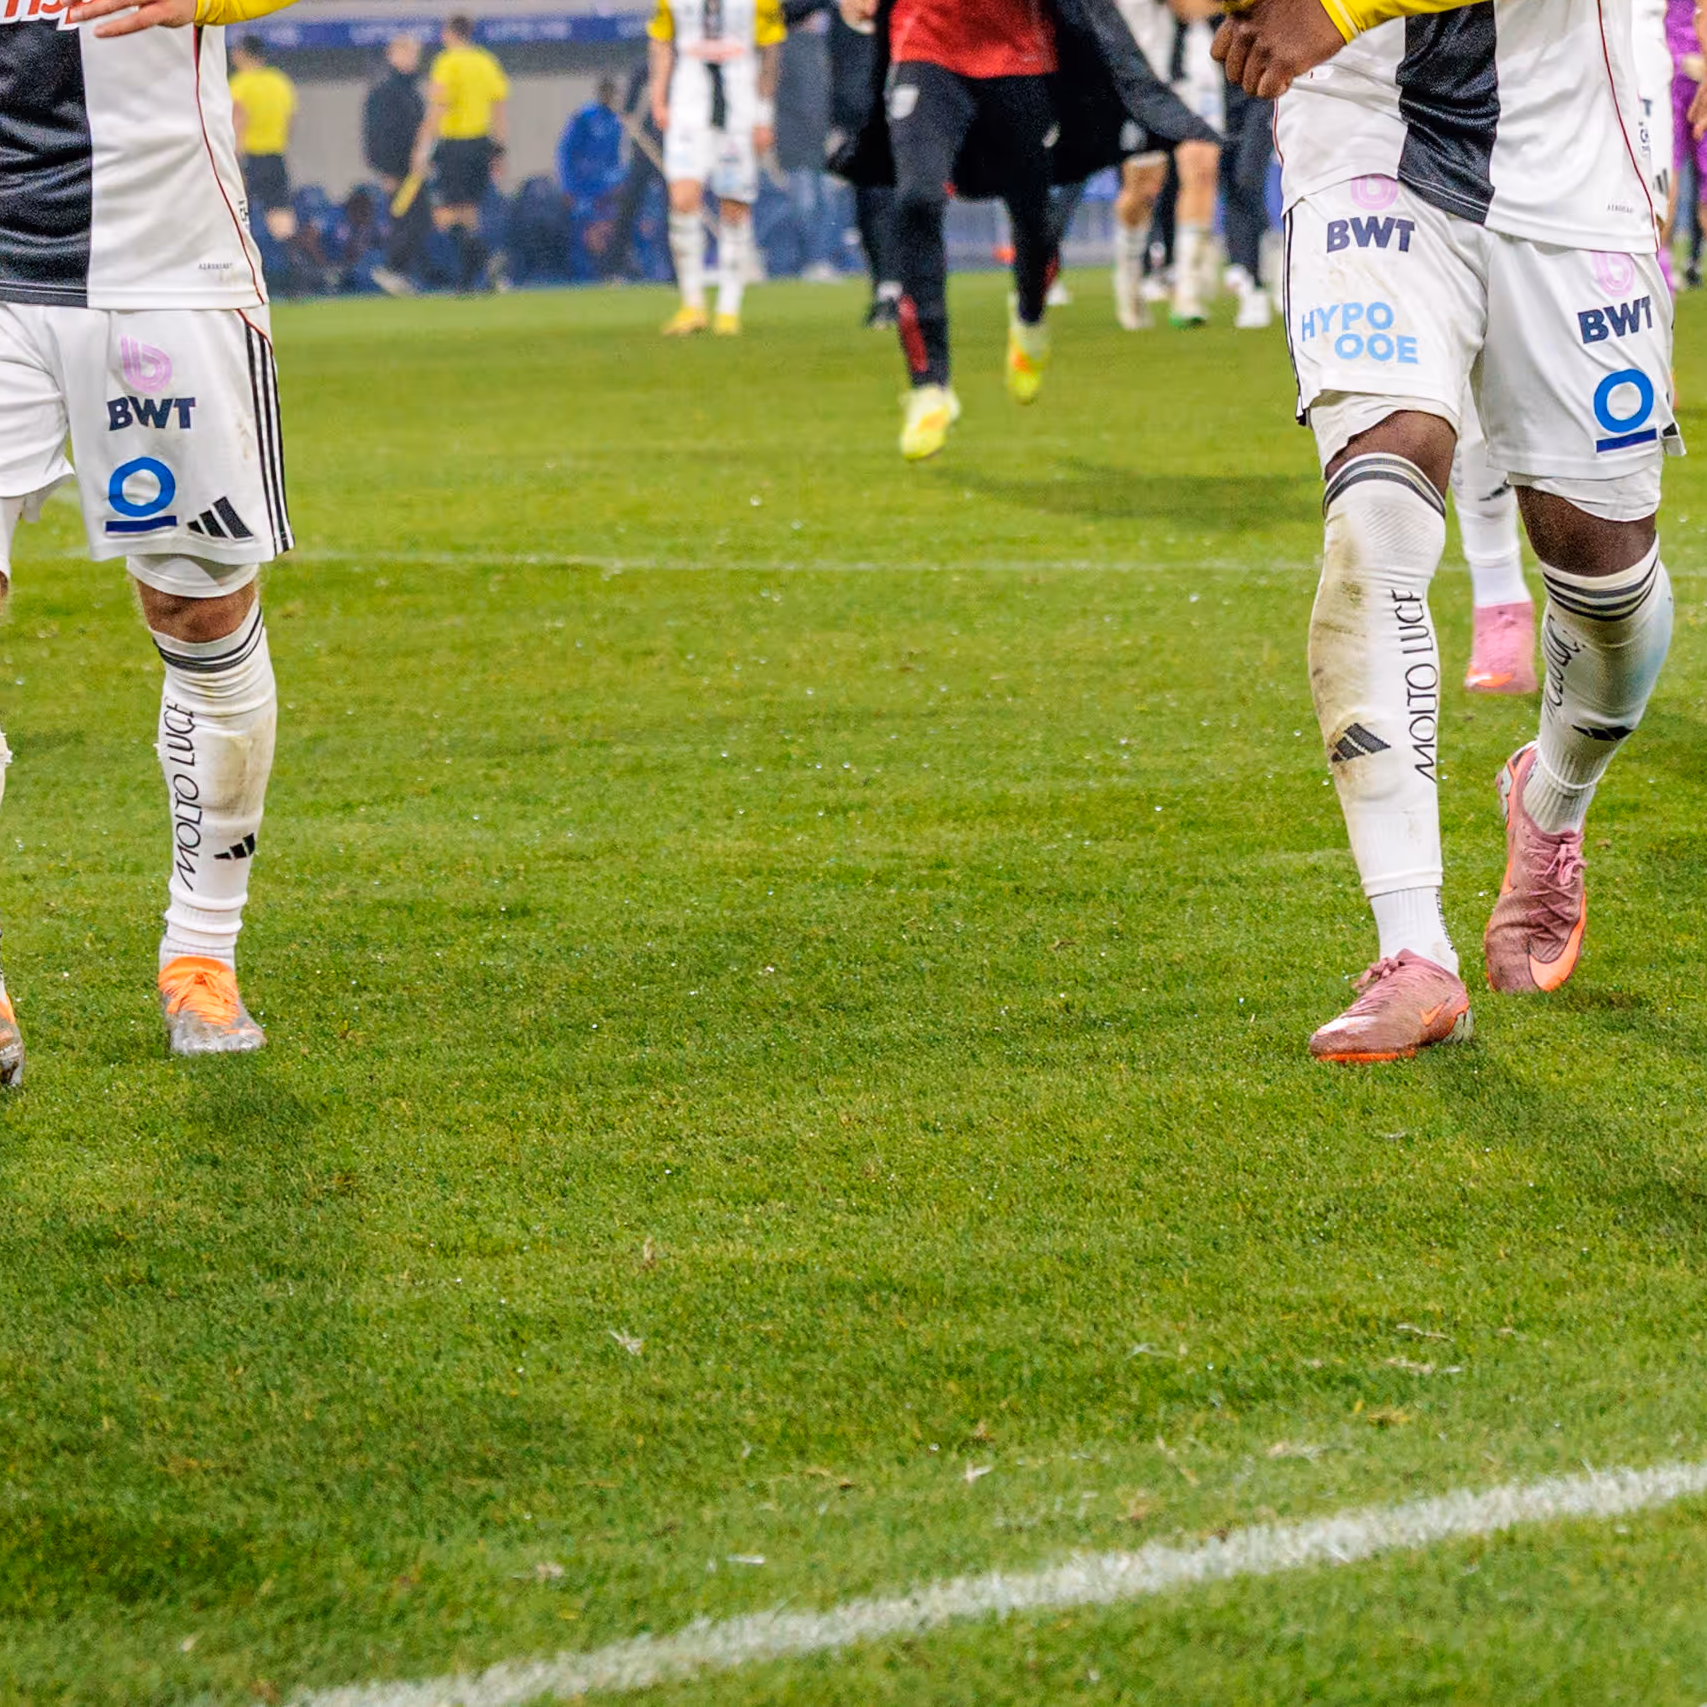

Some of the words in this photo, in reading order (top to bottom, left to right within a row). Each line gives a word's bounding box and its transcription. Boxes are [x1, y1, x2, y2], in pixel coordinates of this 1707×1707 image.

[1327, 216, 1415, 253] BWT
[1302, 302, 1394, 342] HYPO
[1578, 295, 1654, 344] BWT
[1334, 333, 1418, 364] OOE
[107, 396, 196, 432] BWT
[164, 694, 199, 767] LUCE
[1405, 662, 1439, 783] MOLTO
[174, 773, 202, 892] MOLTO
